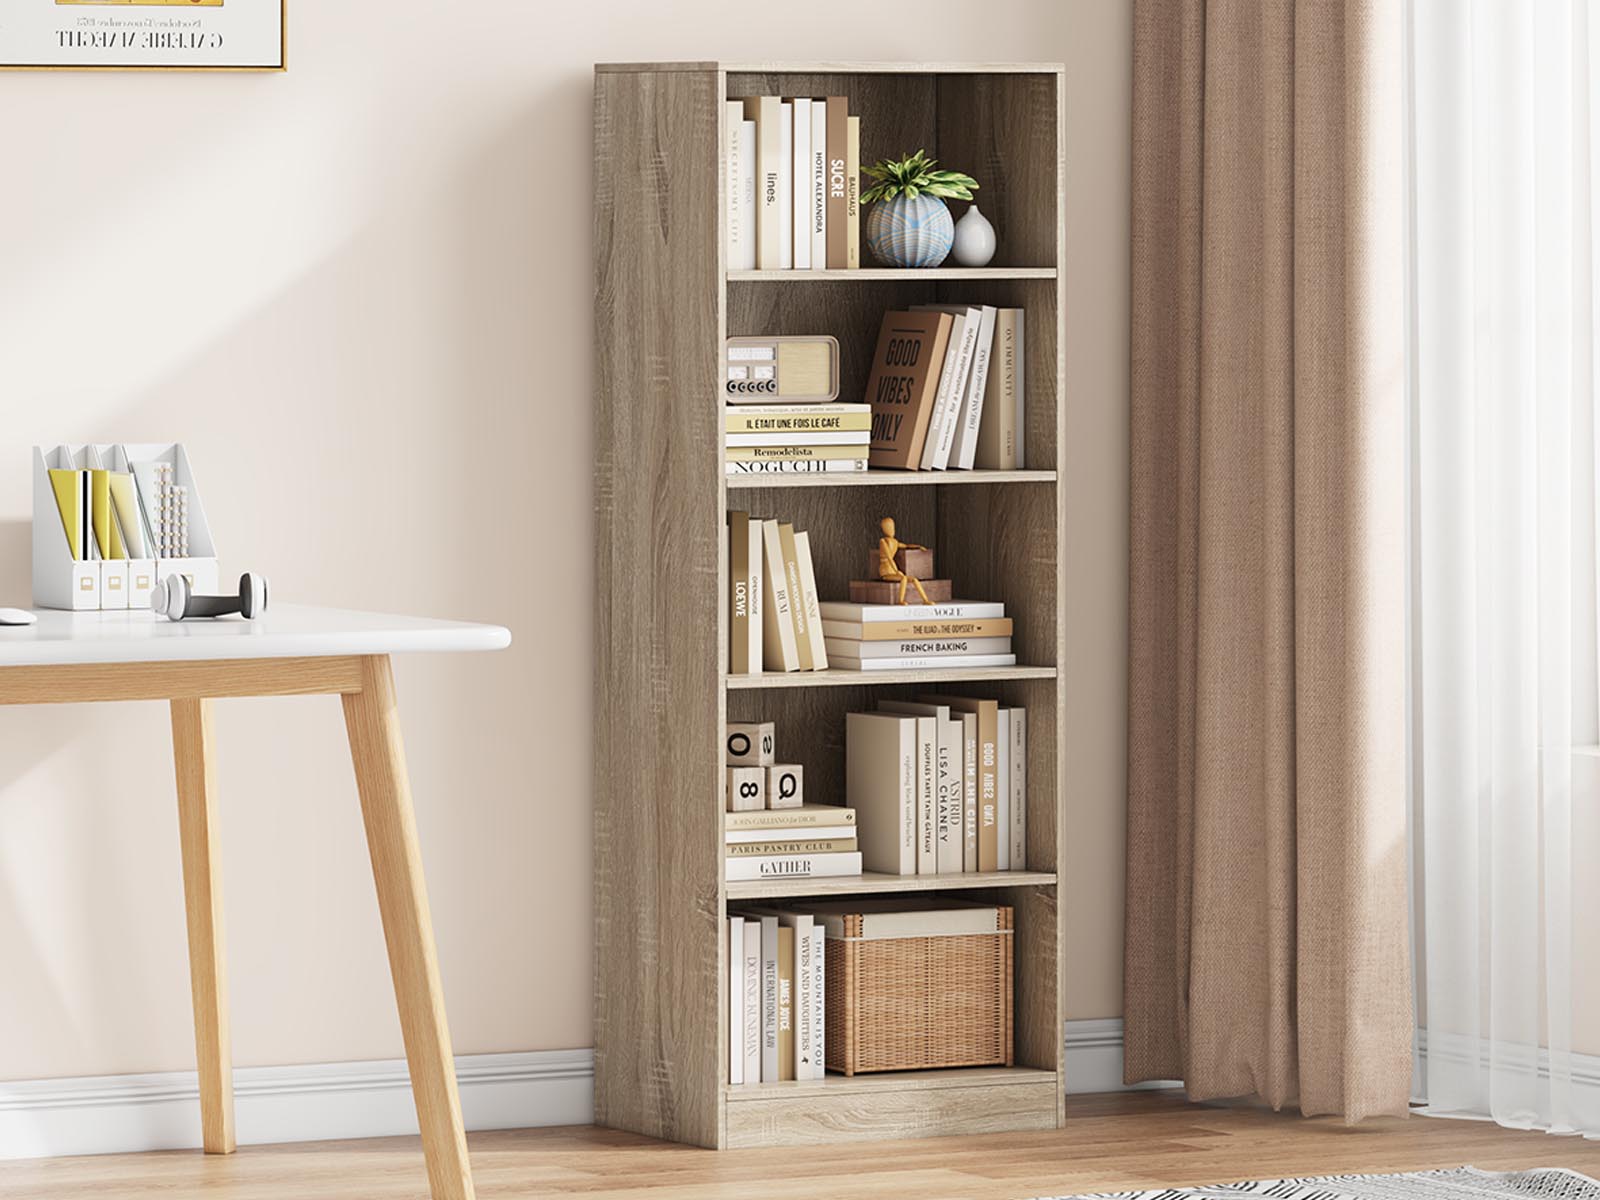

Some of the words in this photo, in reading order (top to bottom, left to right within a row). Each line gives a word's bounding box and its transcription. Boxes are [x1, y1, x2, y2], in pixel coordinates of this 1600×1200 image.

[767, 172, 778, 206] lines.
[831, 159, 844, 198] SUCRE
[886, 338, 921, 368] GOOD
[876, 376, 914, 406] VIBES
[746, 420, 752, 429] IL
[777, 419, 792, 428] UNE
[794, 418, 810, 428] FOIS
[812, 418, 820, 427] LE
[871, 413, 904, 442] ONLY
[735, 460, 827, 473] NOGUCHI
[754, 448, 813, 457] Remodelista
[736, 581, 746, 618] LOEWE
[934, 607, 963, 617] VOGUE
[952, 624, 975, 633] ODYSSEY
[900, 644, 934, 653] FRENCH
[936, 642, 968, 652] BAKING
[939, 747, 948, 778] LISA
[939, 785, 948, 842] CHANEY
[950, 780, 960, 826] ASTRID
[731, 846, 761, 854] PARIS
[764, 844, 801, 853] PASTRY
[760, 861, 811, 874] GATHER
[802, 936, 810, 967] WIVES
[766, 960, 775, 1029] INTERNATIONAL
[802, 969, 810, 991] AND
[802, 992, 810, 1051] DAUGHTERS
[816, 1028, 822, 1040] IS
[766, 1030, 775, 1049] LAW
